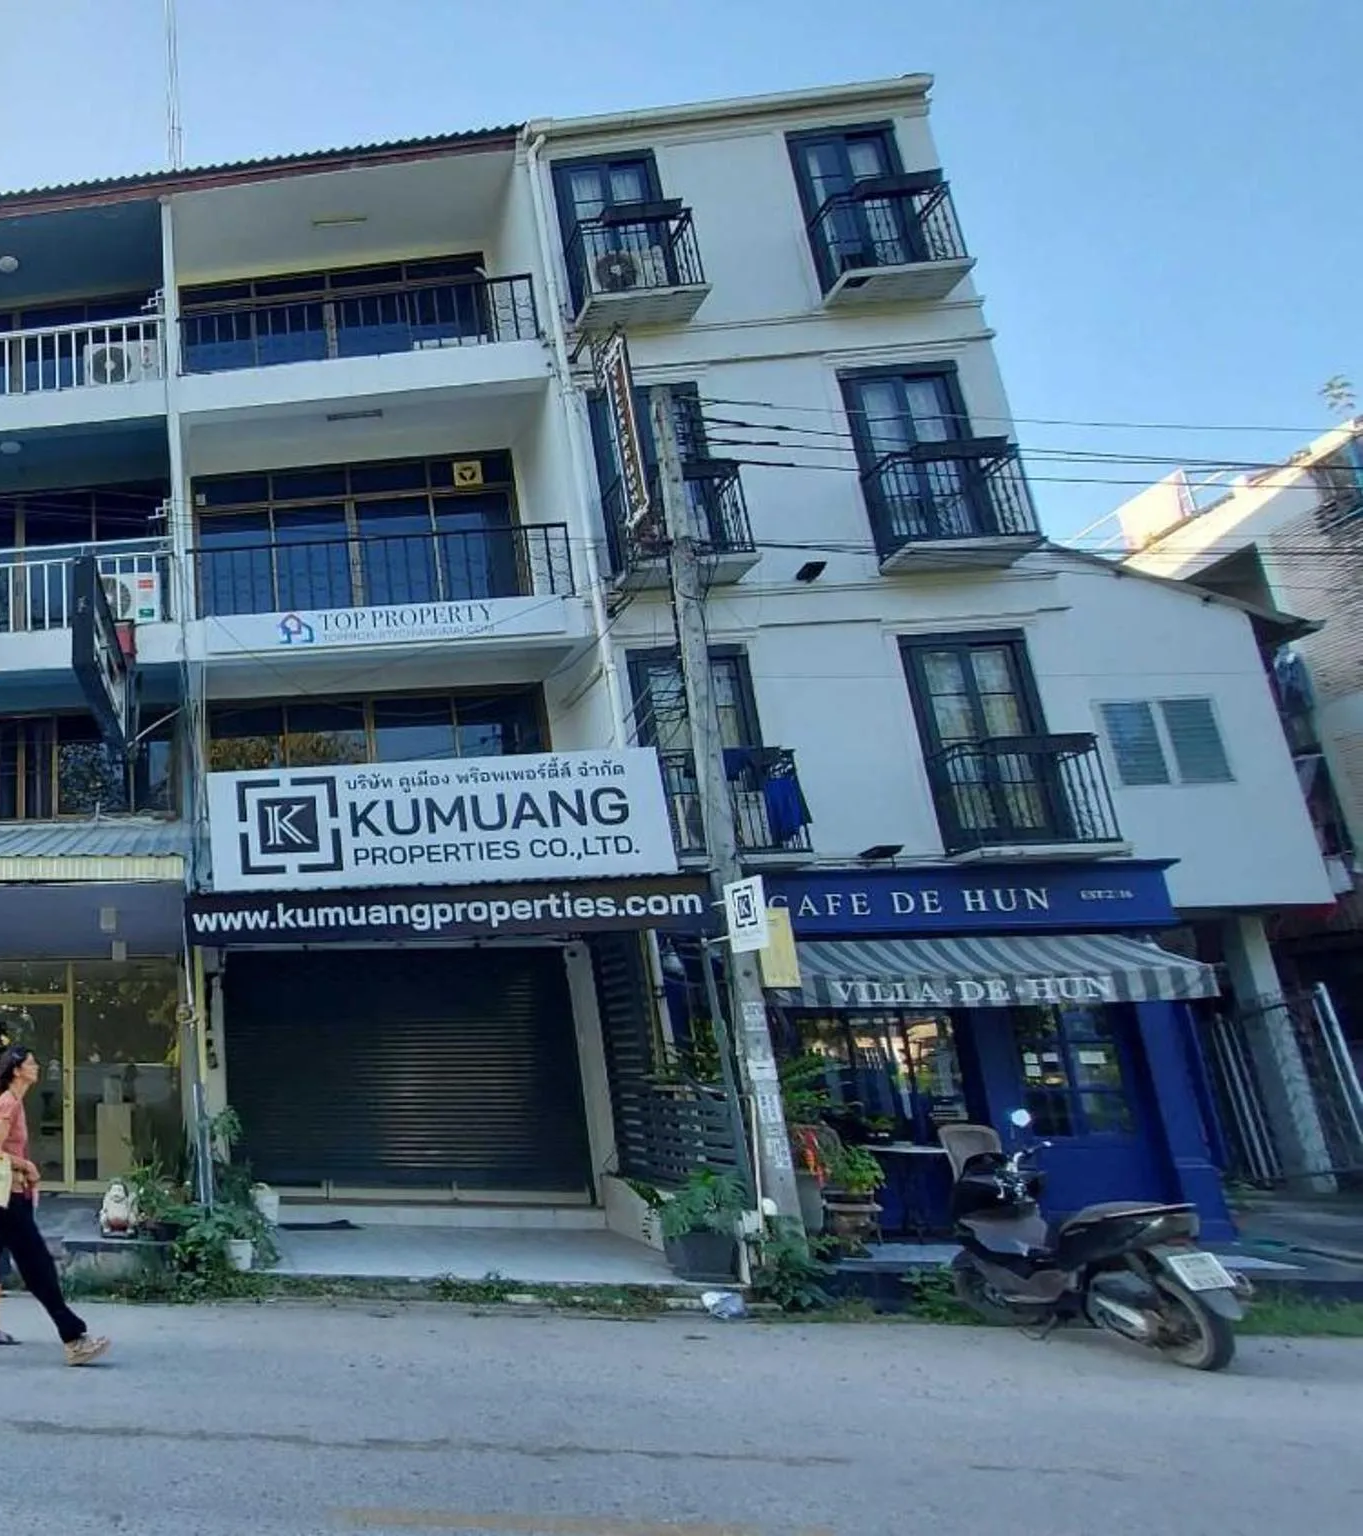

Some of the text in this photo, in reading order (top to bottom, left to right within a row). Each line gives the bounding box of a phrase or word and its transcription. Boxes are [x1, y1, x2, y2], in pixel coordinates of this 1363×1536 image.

[318, 602, 495, 632] TOP PROPERTY
[345, 769, 394, 791] บริษัท
[399, 769, 450, 793] คูเมือง
[577, 759, 625, 778] จำกัด
[348, 786, 630, 838] KUMUANG
[353, 834, 641, 867] PROPERTIES CO.,LTD.
[192, 890, 703, 932] www.kumuangproperties.com
[890, 890, 943, 915] DE
[963, 887, 1051, 912] HUN
[831, 974, 1113, 1003] VILLA DE HUN
